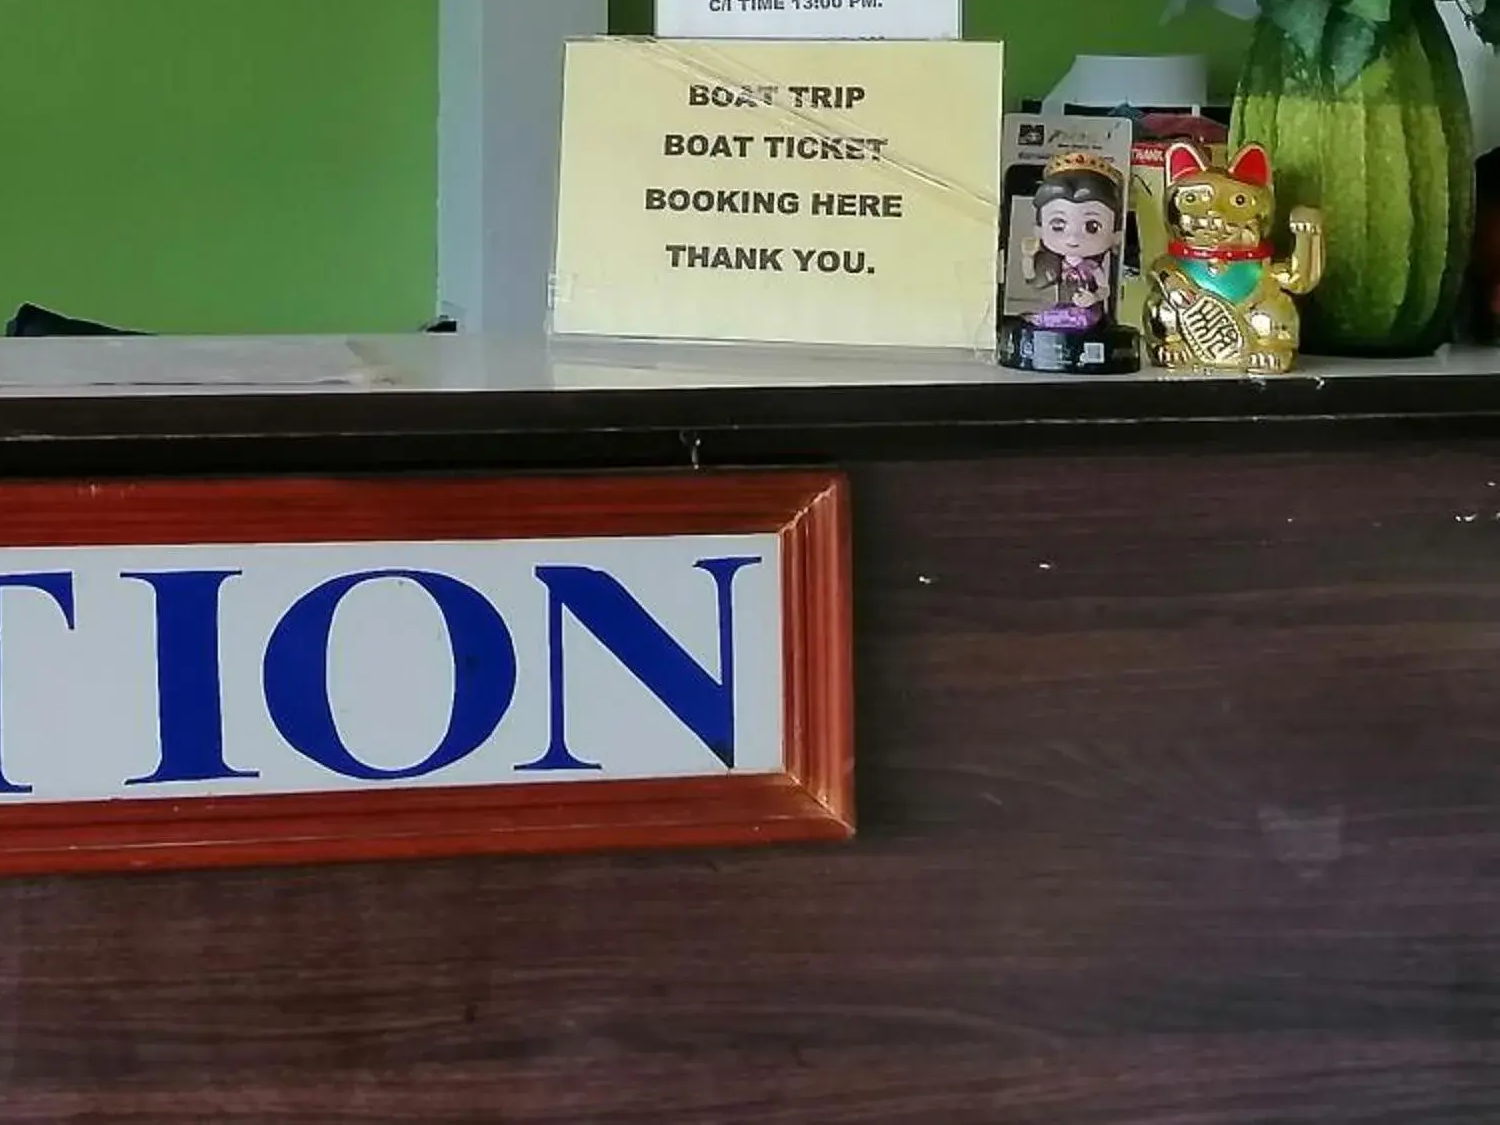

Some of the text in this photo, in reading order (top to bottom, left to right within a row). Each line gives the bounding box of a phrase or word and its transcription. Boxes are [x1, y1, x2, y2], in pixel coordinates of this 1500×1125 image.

[688, 84, 866, 109] BOAT TRIP
[664, 134, 889, 162] BOAT TICKET
[644, 188, 903, 218] BOOKING HERE
[665, 244, 876, 275] THANK YOU.
